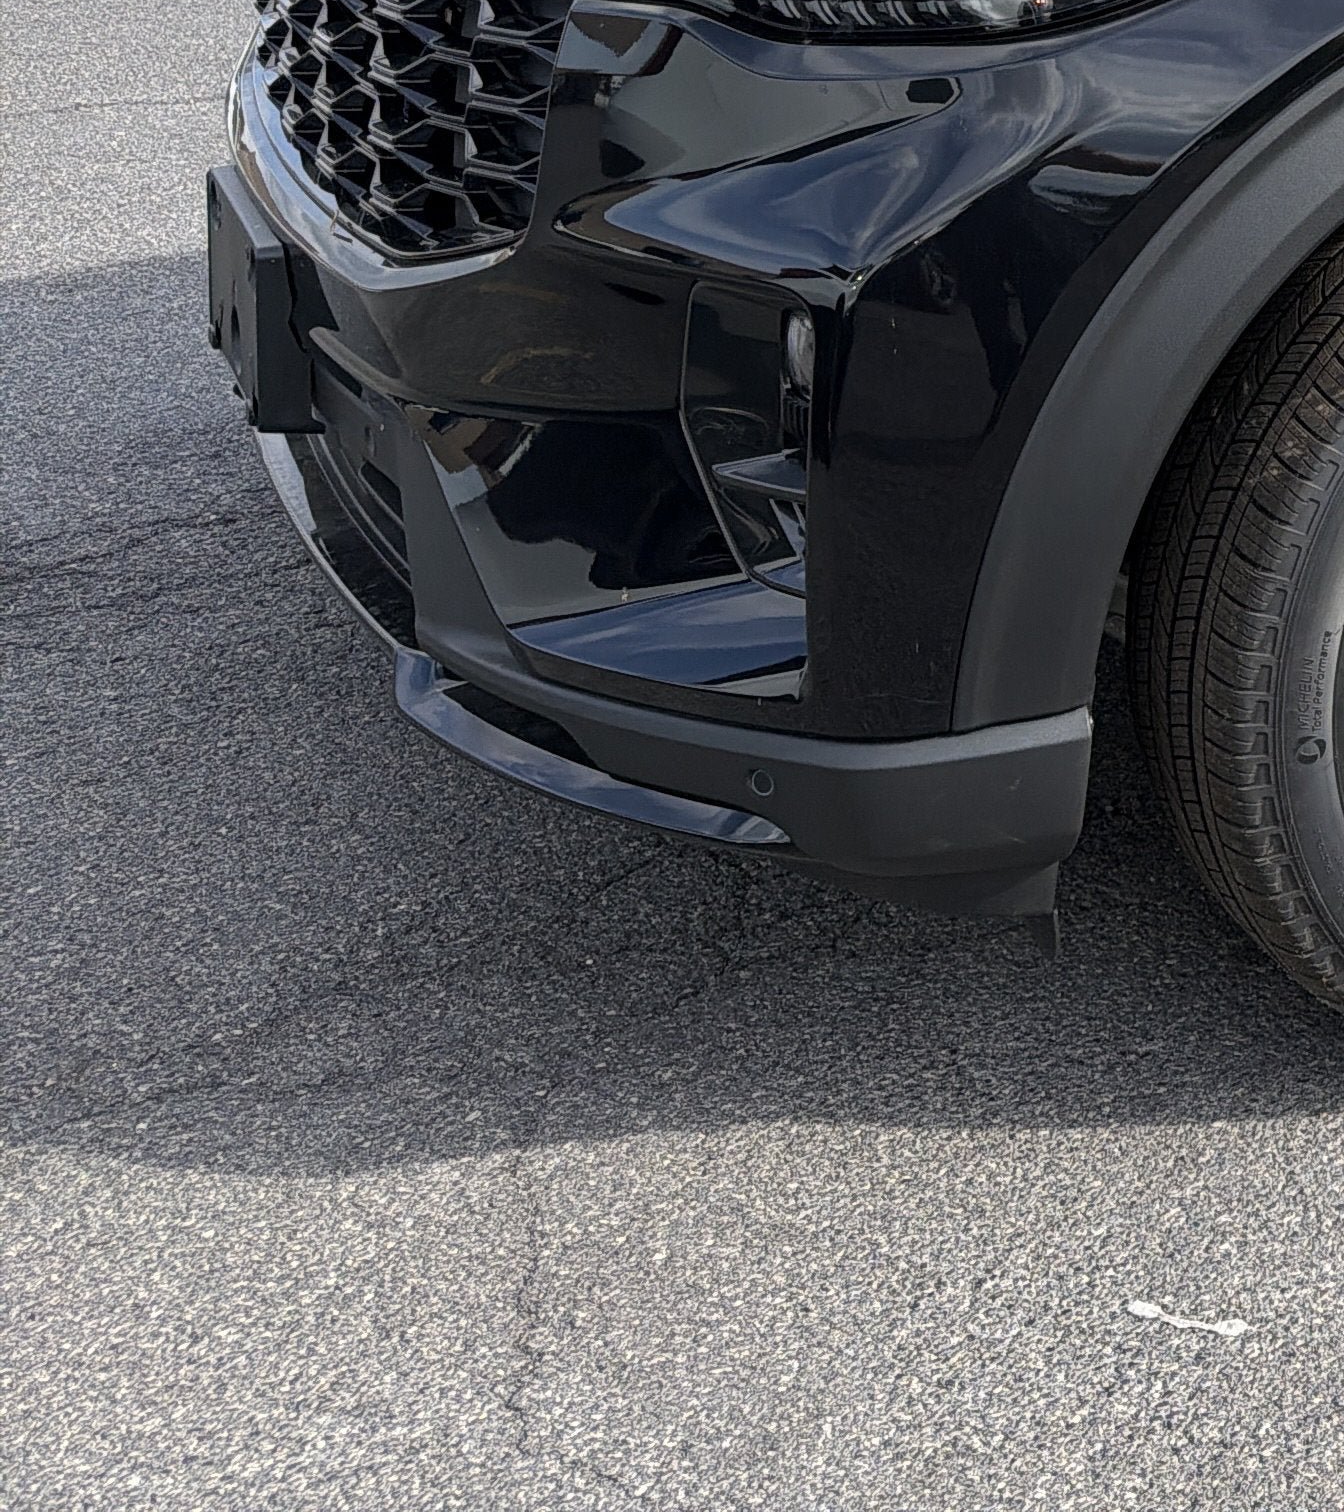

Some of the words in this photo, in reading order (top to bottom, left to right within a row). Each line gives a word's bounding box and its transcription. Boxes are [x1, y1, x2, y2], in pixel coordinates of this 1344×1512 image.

[1298, 656, 1314, 731] MICHELIN
[1313, 630, 1333, 704] Performance
[1312, 705, 1323, 733] Total
